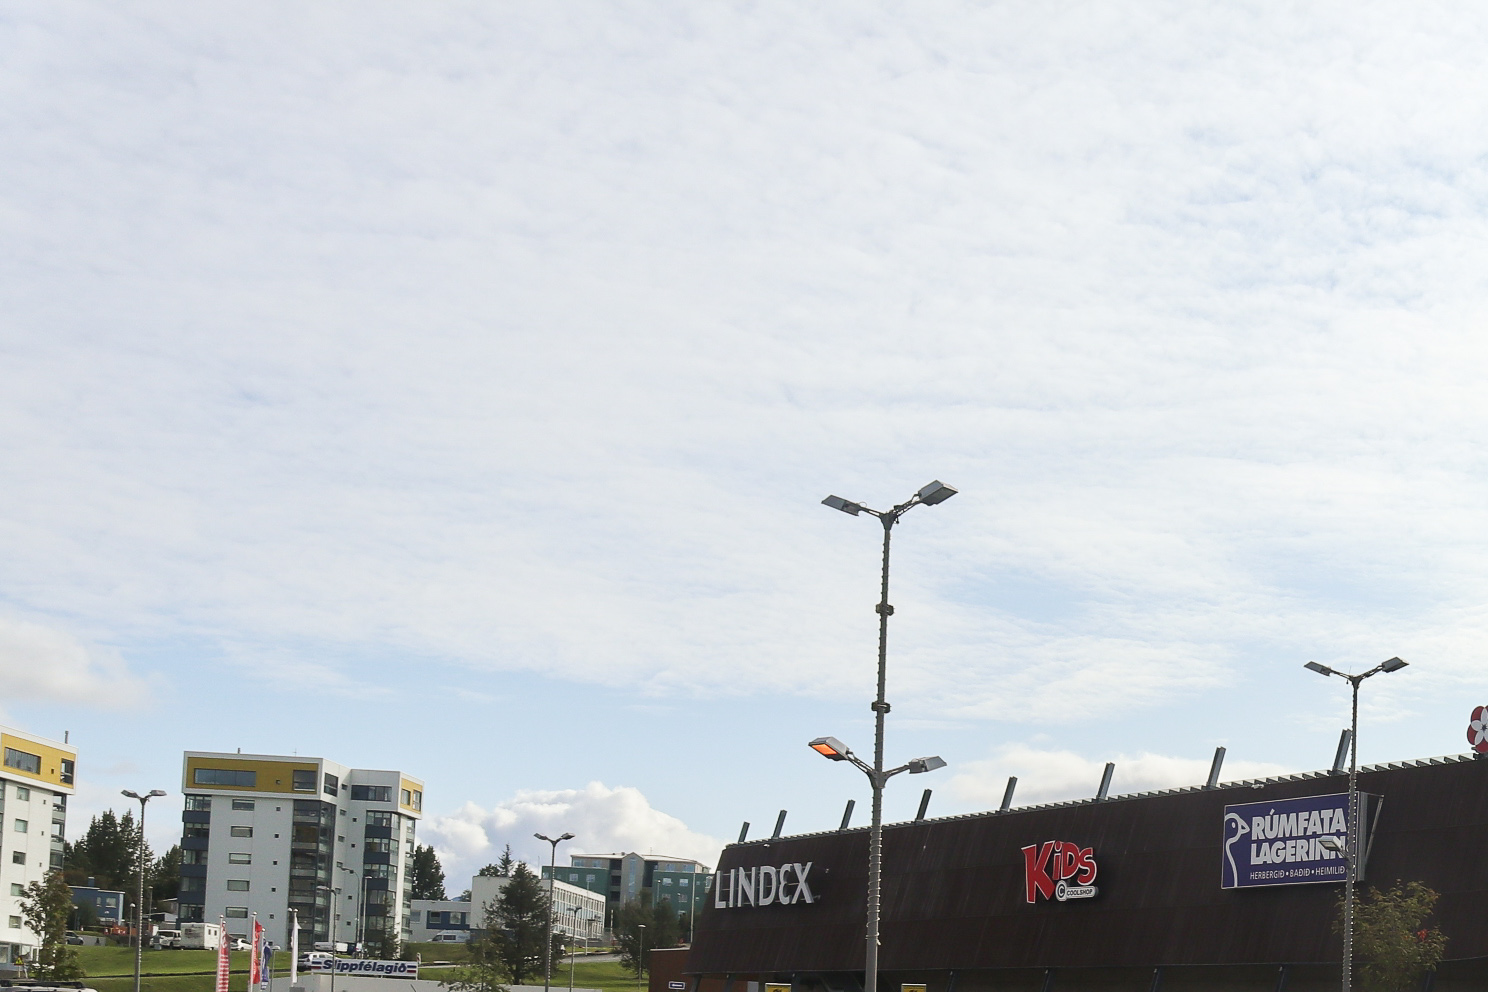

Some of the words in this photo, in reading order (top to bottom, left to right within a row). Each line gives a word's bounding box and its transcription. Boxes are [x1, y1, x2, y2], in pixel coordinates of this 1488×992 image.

[1251, 808, 1347, 840] RÚMFATA
[715, 862, 815, 909] LINDEX
[1250, 870, 1285, 880] HERBERGIÐ
[1289, 868, 1310, 878] BAÐIÐ
[1315, 865, 1346, 875] HEIMILIÐ
